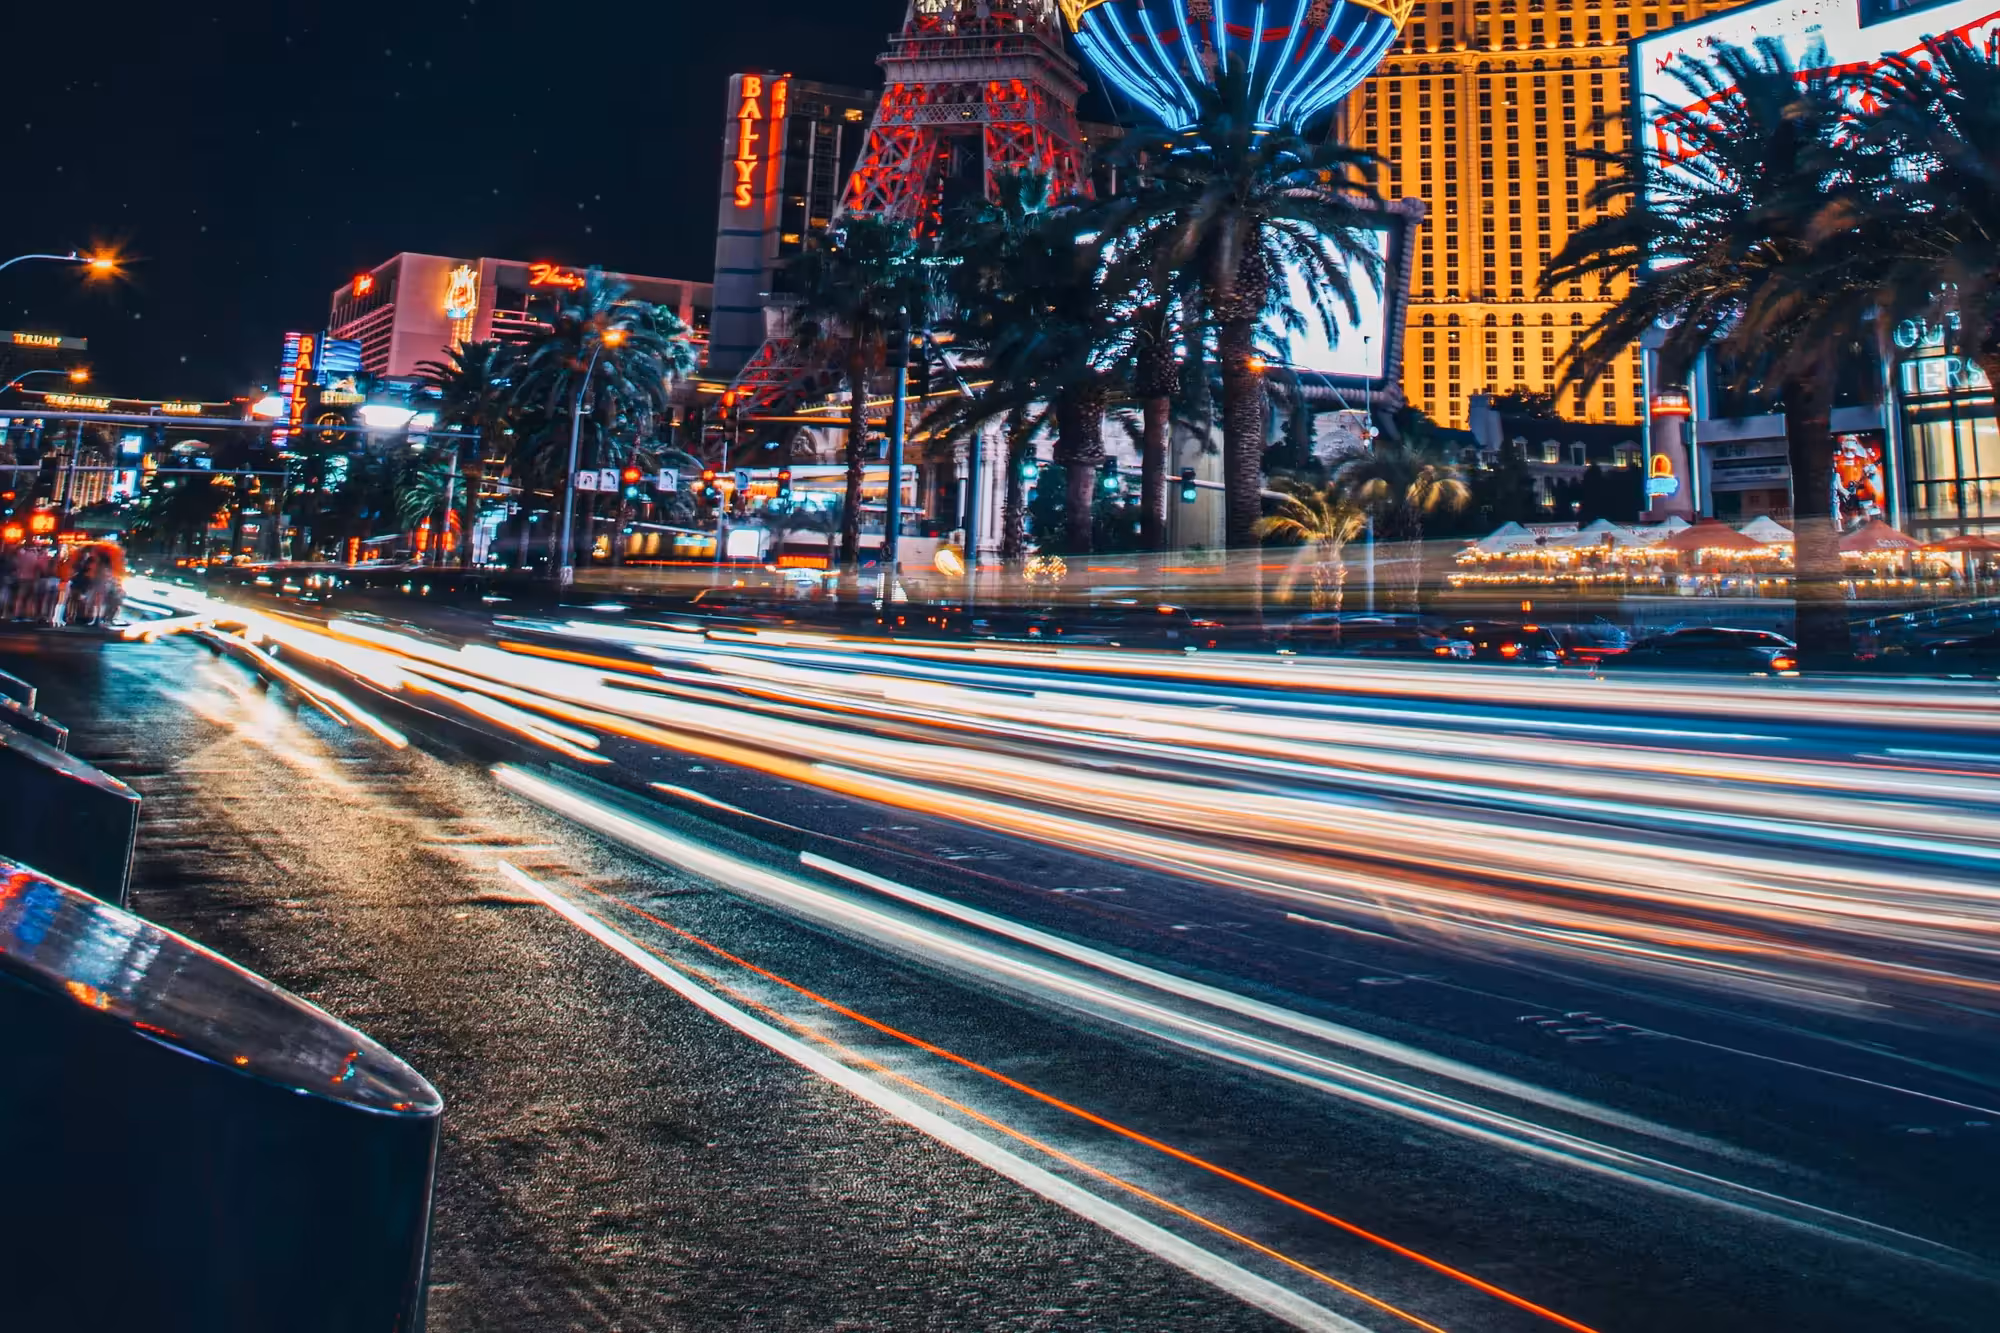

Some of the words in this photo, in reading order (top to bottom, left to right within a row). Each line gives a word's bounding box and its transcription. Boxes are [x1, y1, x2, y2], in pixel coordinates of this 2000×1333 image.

[733, 76, 762, 206] BALLYS
[13, 333, 62, 347] TRUMP
[45, 394, 111, 409] TREASURE
